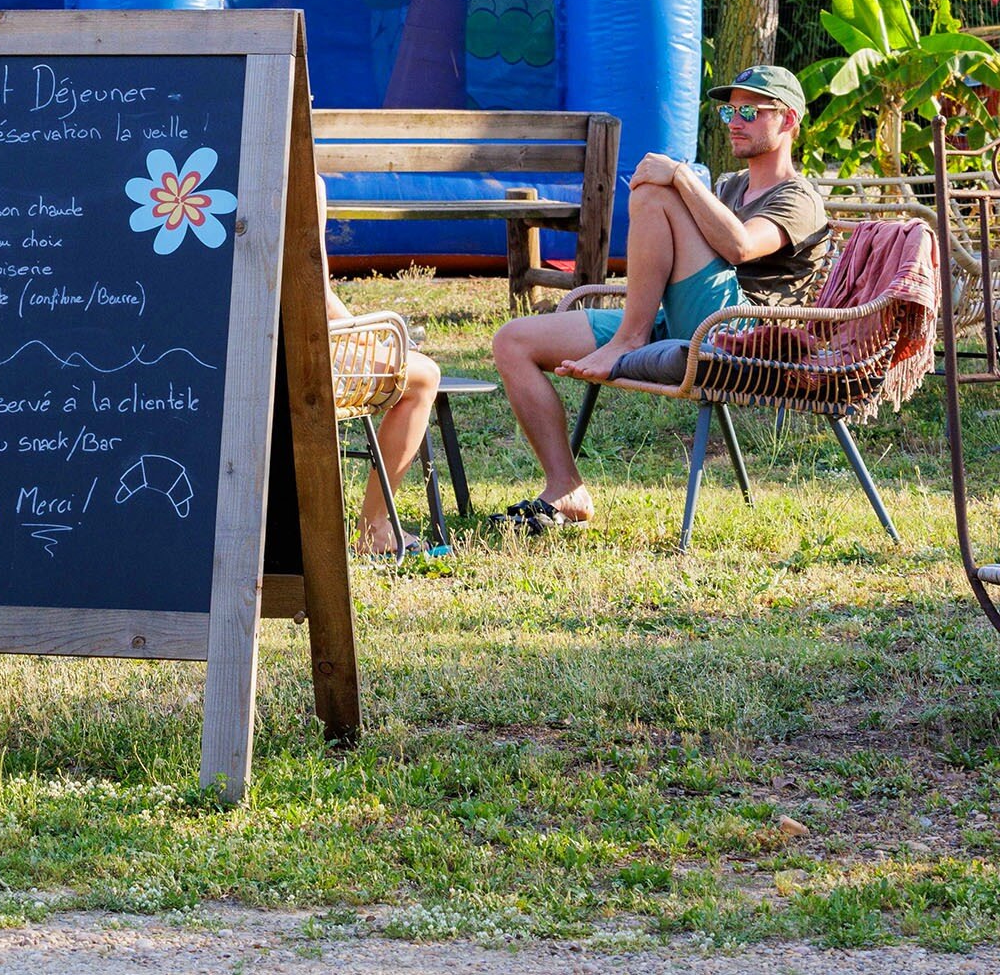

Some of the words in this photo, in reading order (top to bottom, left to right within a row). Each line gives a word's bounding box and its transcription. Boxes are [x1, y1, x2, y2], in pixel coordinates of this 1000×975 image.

[30, 64, 155, 120] Déjeuner
[116, 113, 131, 141] la
[143, 115, 188, 139] veille
[22, 230, 62, 248] choix
[63, 385, 80, 412] à
[93, 381, 110, 412] la
[19, 425, 122, 461] snack/Bar
[16, 487, 74, 515] Merci
